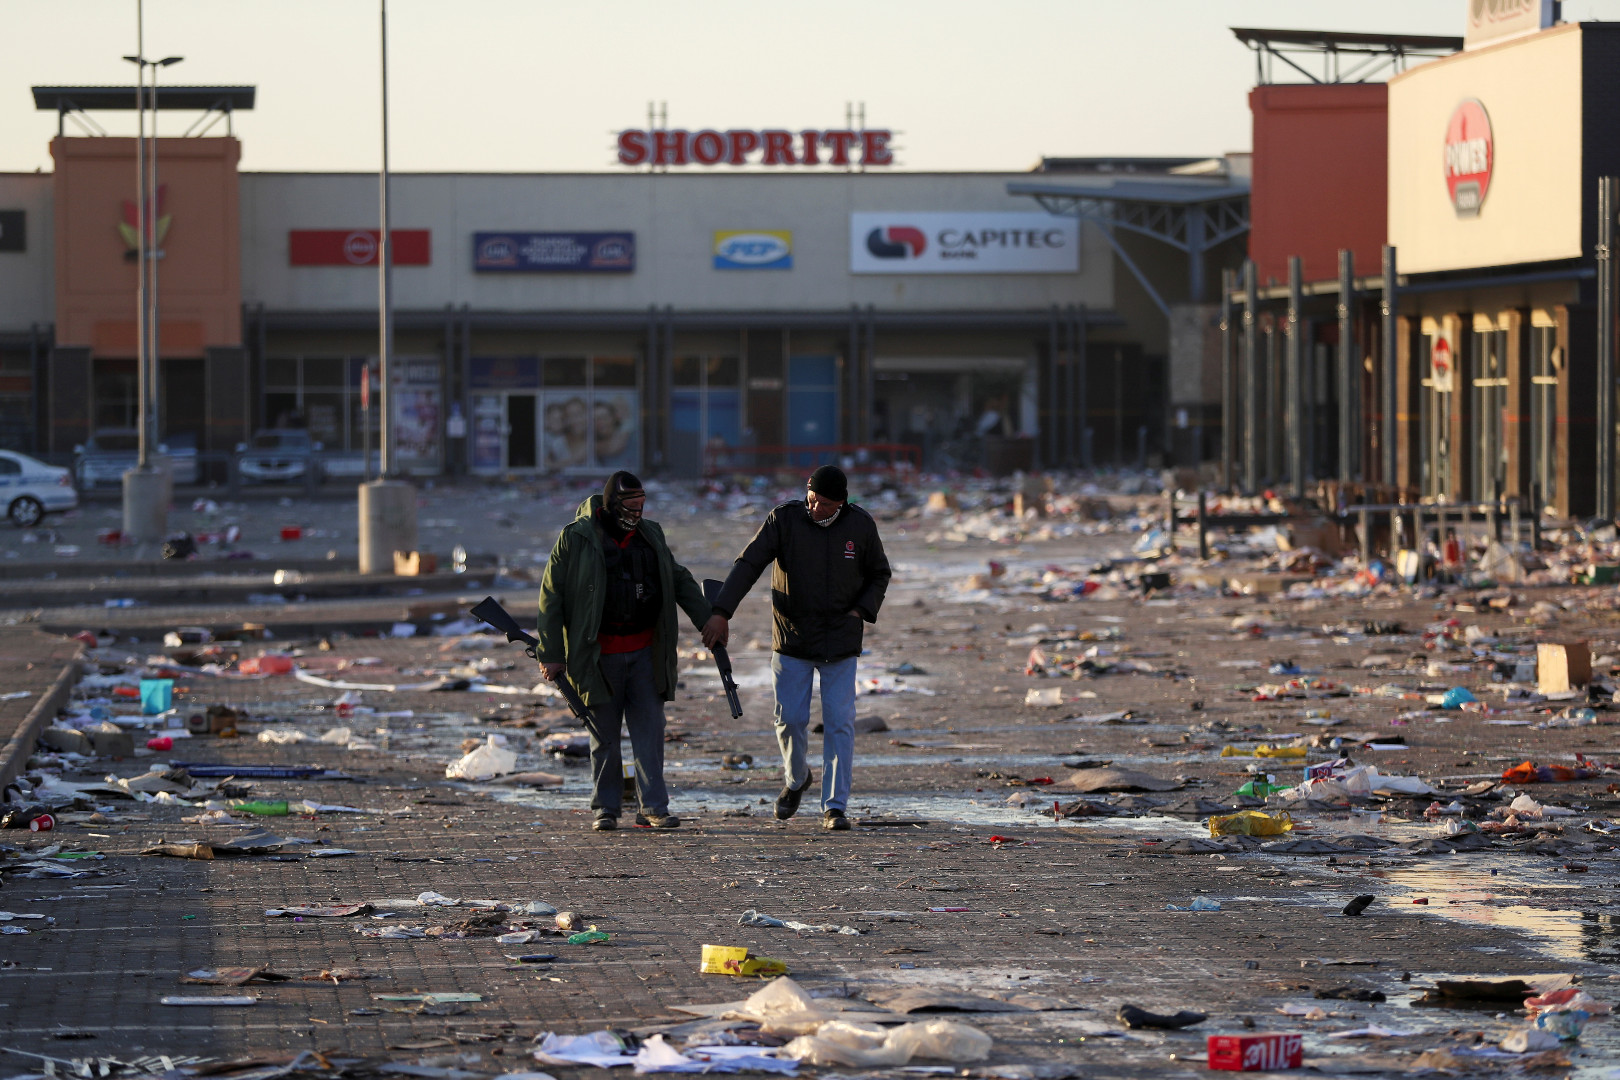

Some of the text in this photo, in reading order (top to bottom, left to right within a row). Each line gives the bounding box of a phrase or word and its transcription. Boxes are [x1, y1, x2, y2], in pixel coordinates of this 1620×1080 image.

[617, 129, 893, 166] SHOPRITE
[1446, 138, 1488, 177] POWER
[938, 228, 1066, 249] CAPITEC
